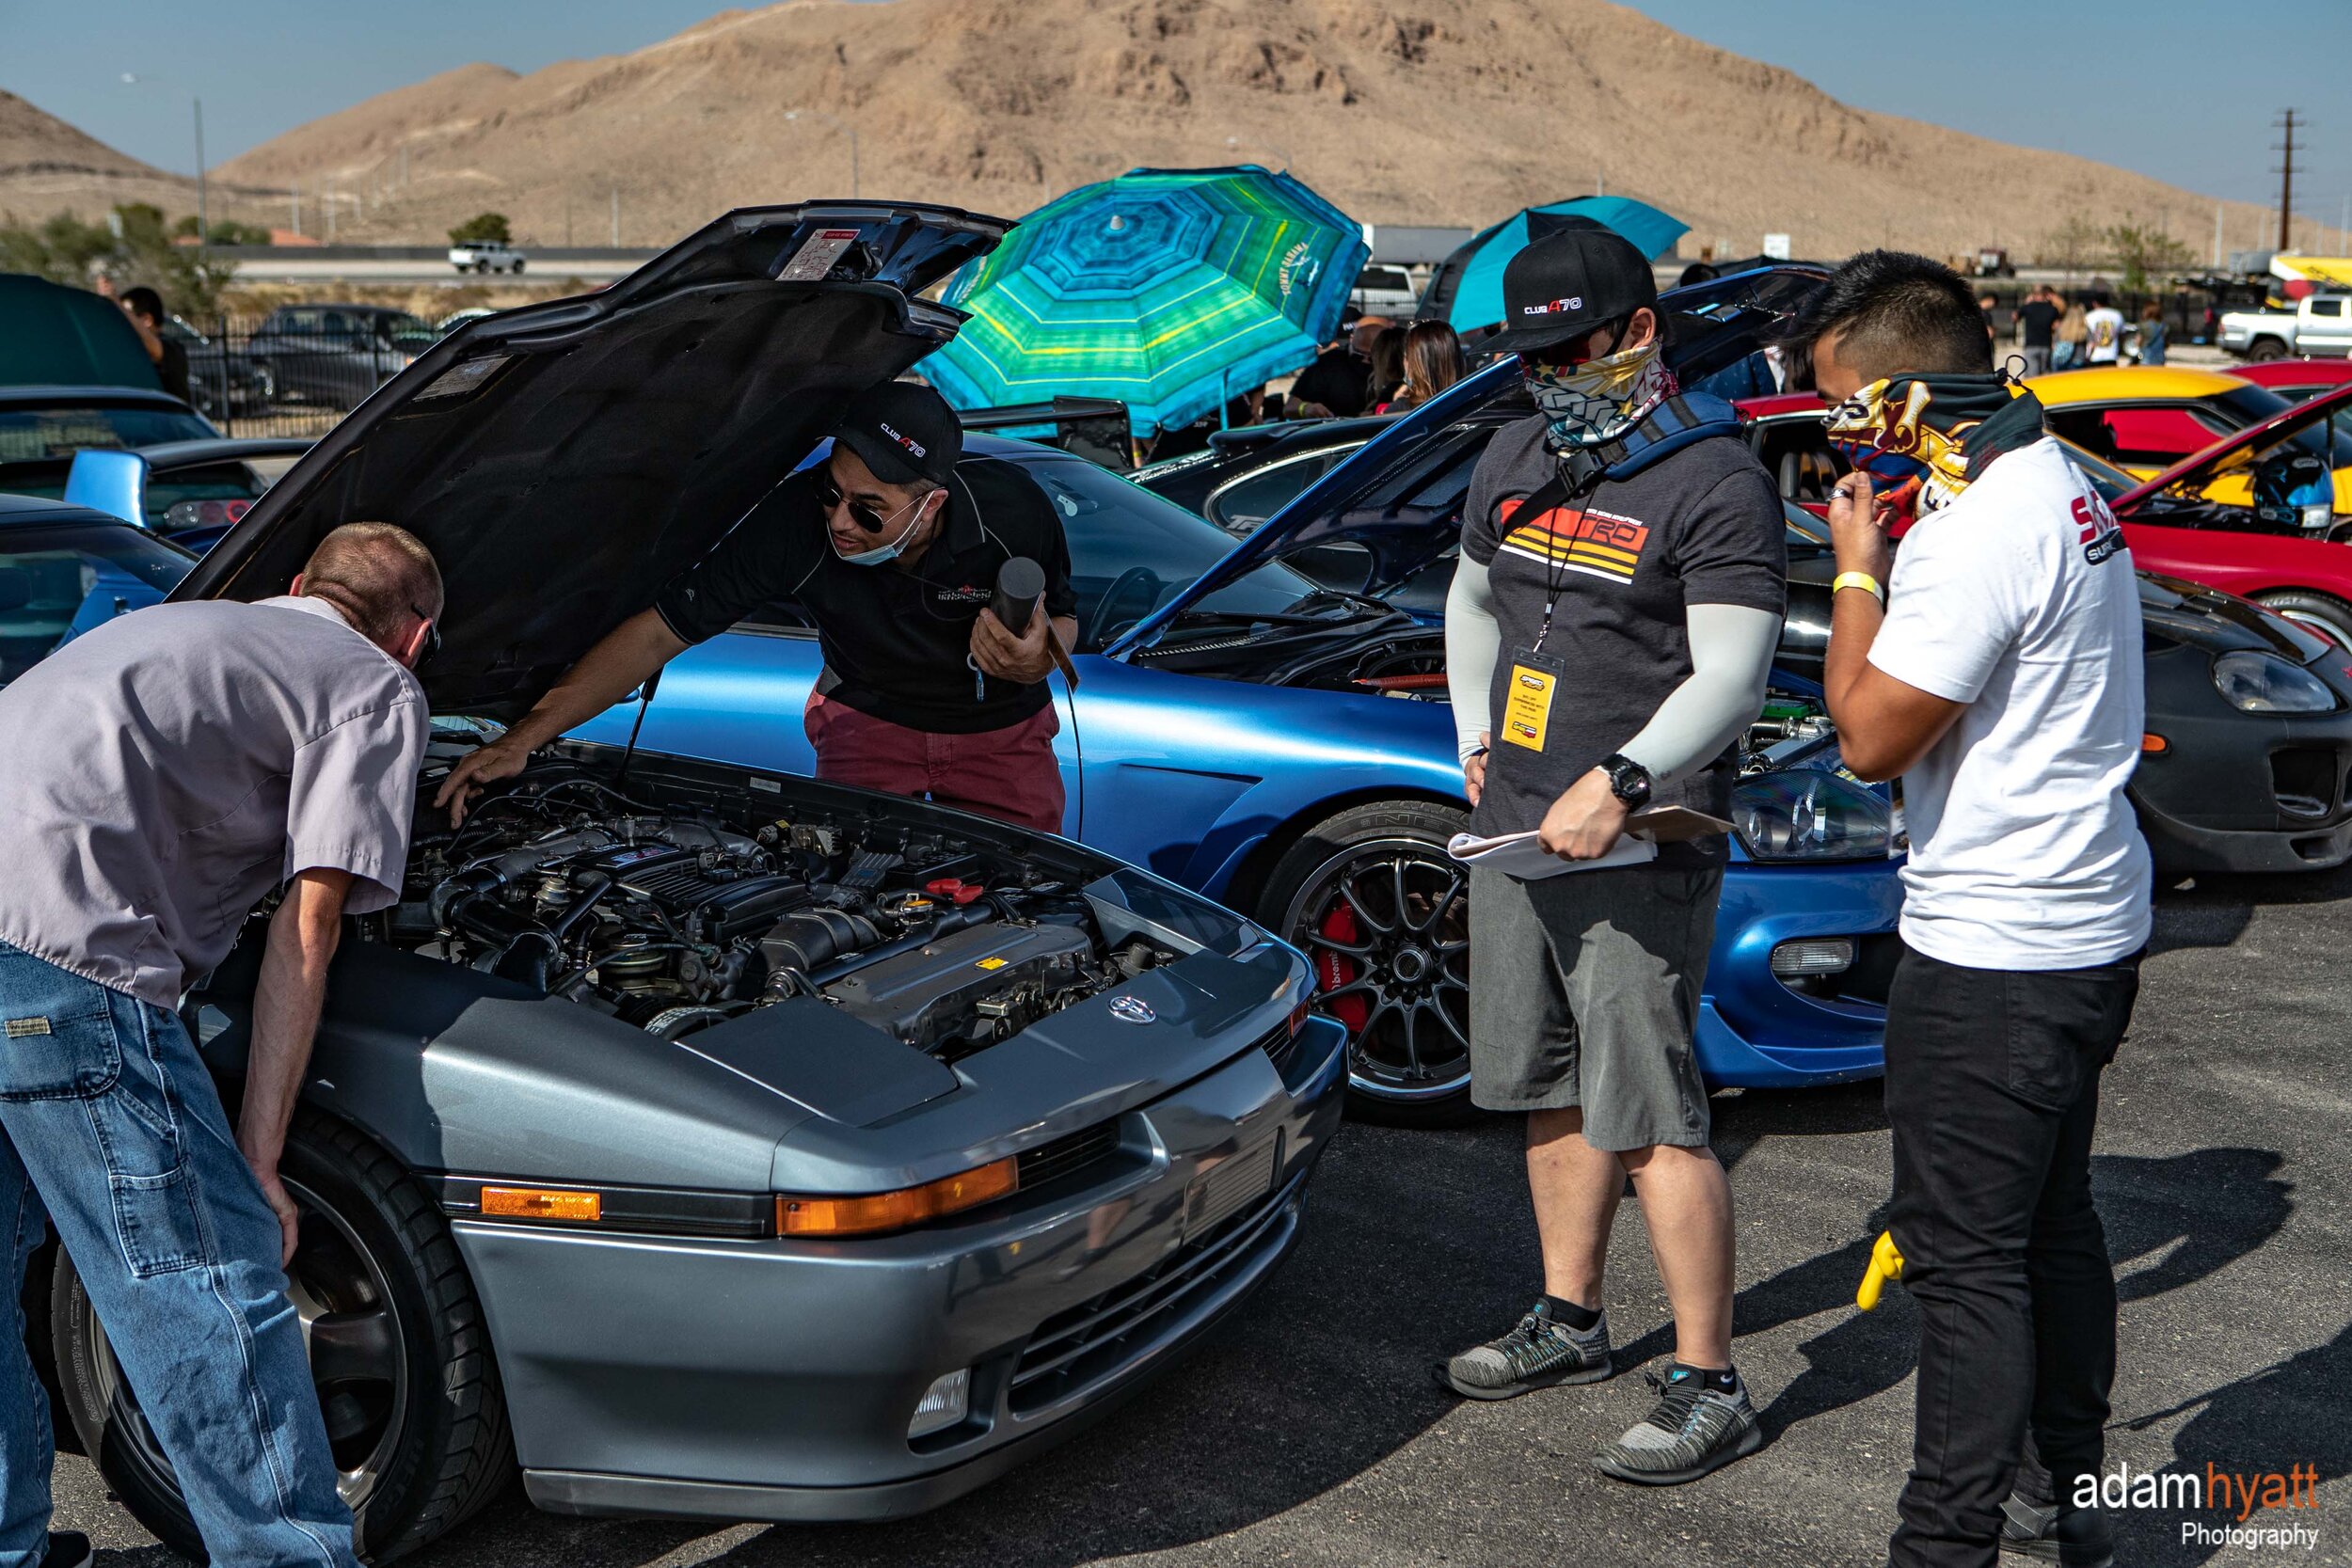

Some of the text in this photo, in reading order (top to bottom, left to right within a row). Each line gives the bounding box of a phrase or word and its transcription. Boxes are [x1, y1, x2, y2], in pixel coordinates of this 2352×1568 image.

[1279, 242, 1309, 295] TOMMY BAHAMA
[1328, 950, 1342, 984] bremb
